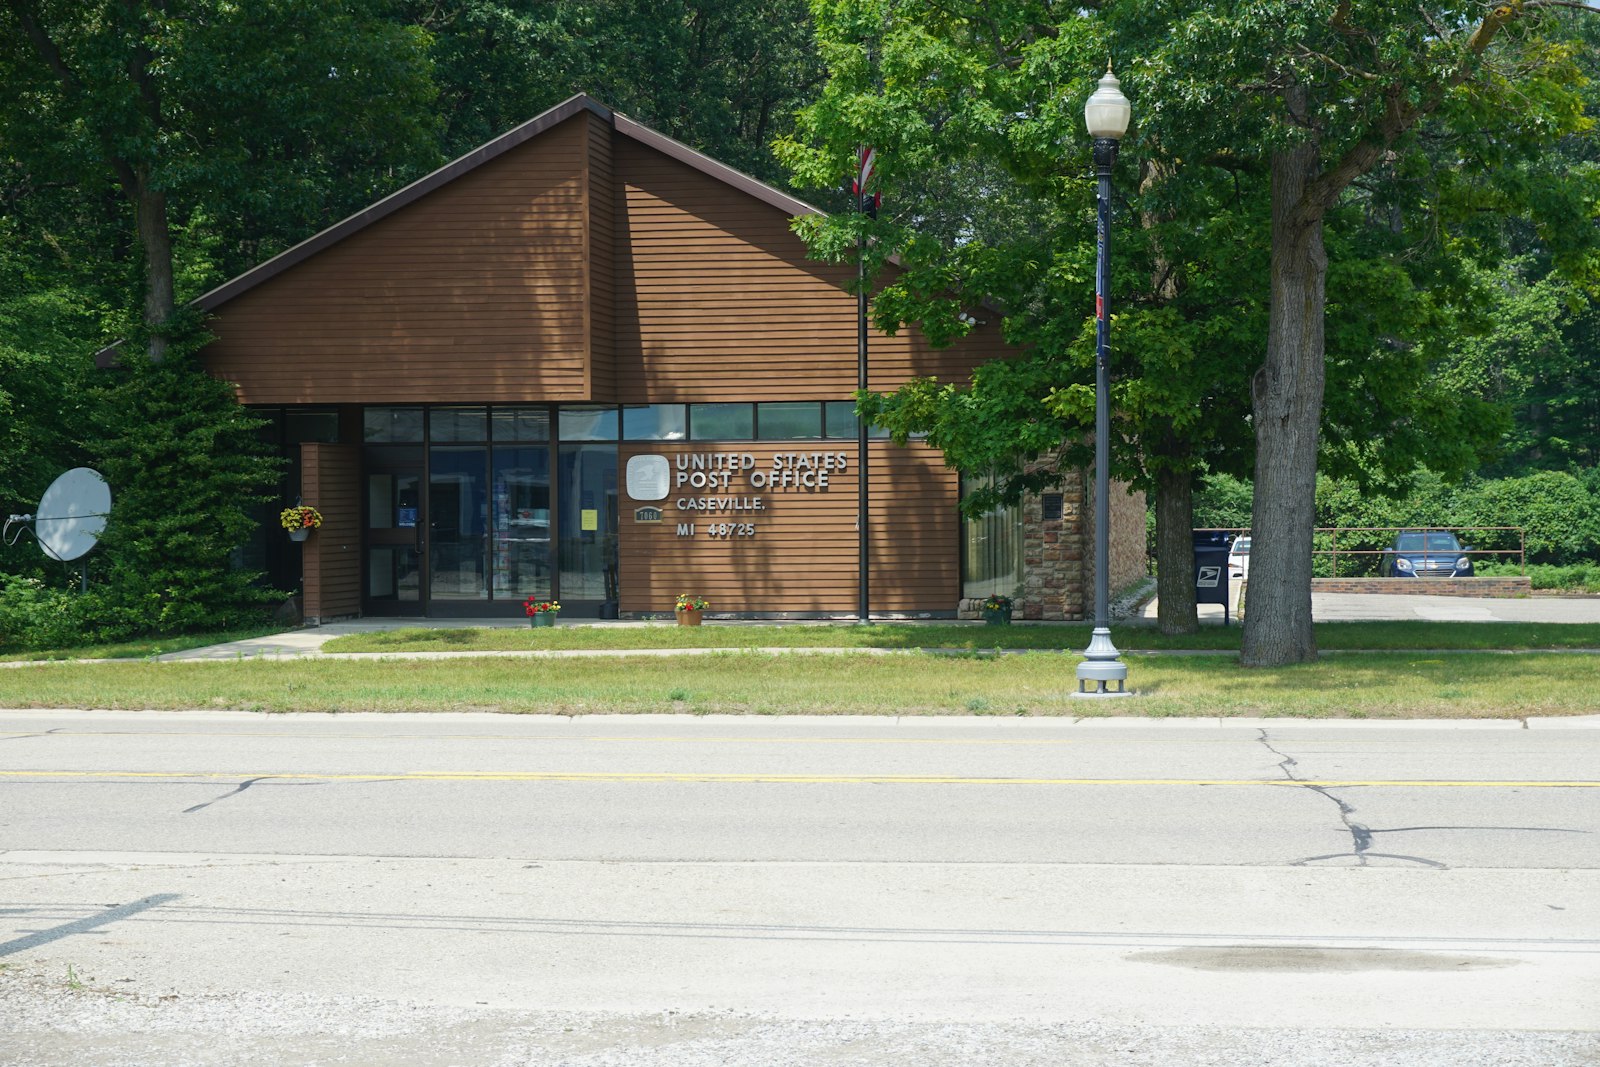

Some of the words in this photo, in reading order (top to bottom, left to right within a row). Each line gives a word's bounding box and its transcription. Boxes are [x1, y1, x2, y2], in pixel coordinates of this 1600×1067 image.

[676, 453, 755, 470] UNITED
[773, 452, 847, 469] STATES
[676, 471, 732, 488] POST
[750, 470, 828, 488] OFFICE
[676, 523, 695, 536] MI
[708, 523, 755, 536] 48725
